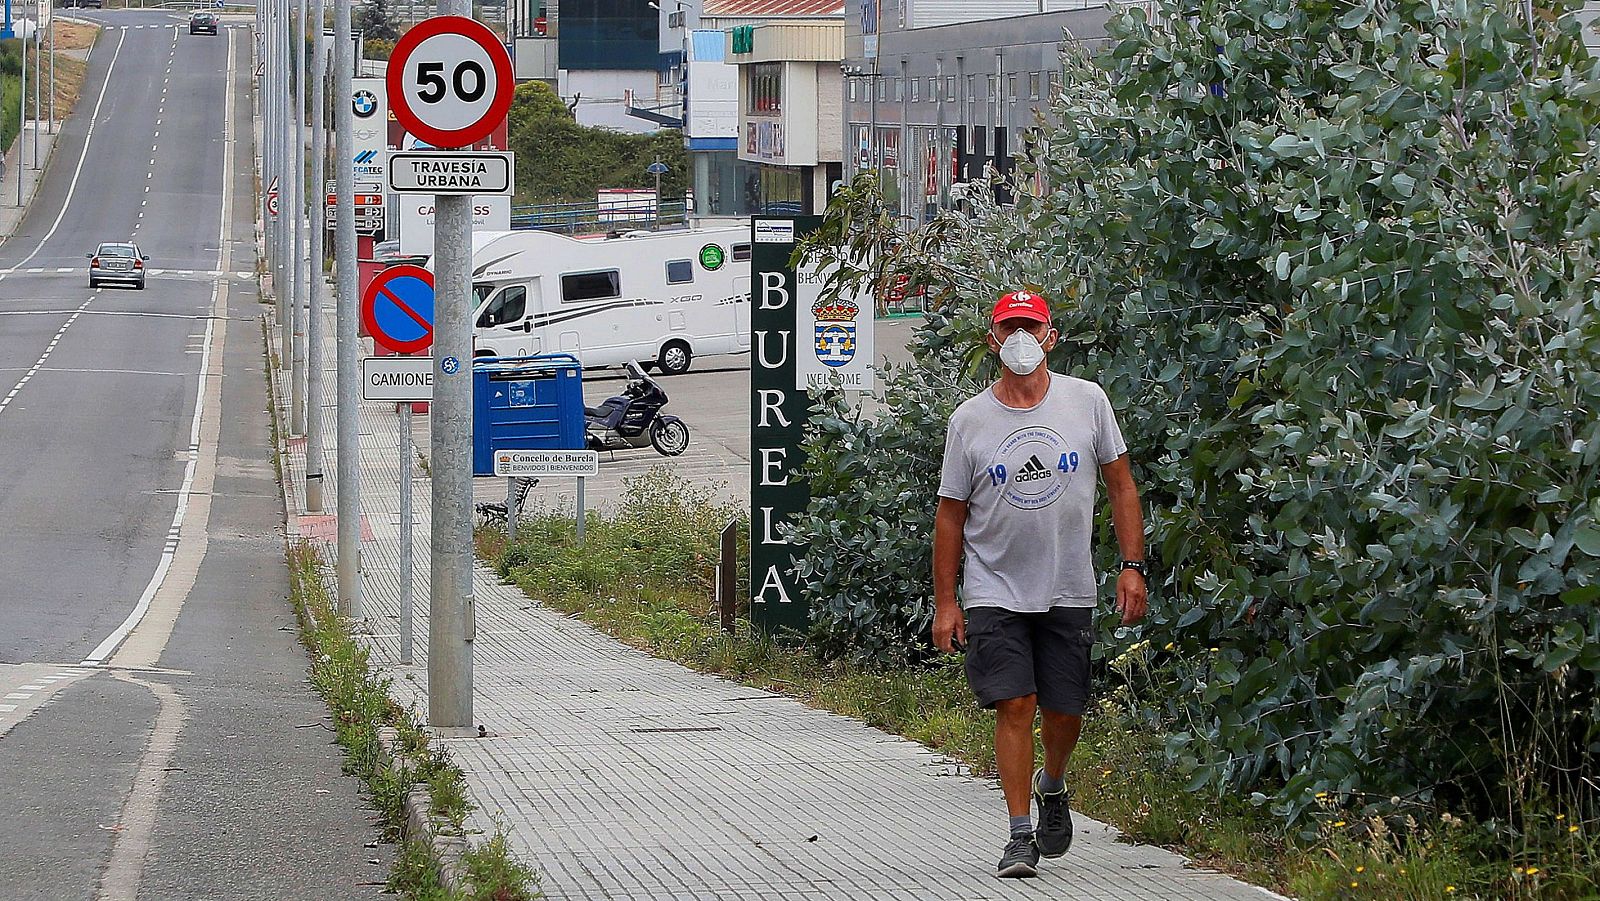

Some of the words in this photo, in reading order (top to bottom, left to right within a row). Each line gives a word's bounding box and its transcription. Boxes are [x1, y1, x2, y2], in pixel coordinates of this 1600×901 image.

[416, 61, 487, 104] 50
[353, 166, 383, 174] ECATEC
[411, 159, 487, 173] TRAVESÍA
[417, 175, 481, 187] URBANA
[418, 206, 490, 216] CASS
[371, 372, 434, 386] CAMIONE
[806, 373, 862, 385] WELOME
[754, 271, 792, 604] BURELA
[512, 453, 550, 463] Concello
[552, 453, 562, 463] de
[565, 453, 594, 463] Burela
[1057, 451, 1079, 473] 49
[987, 464, 1007, 486] 19
[1014, 469, 1052, 483] adidas
